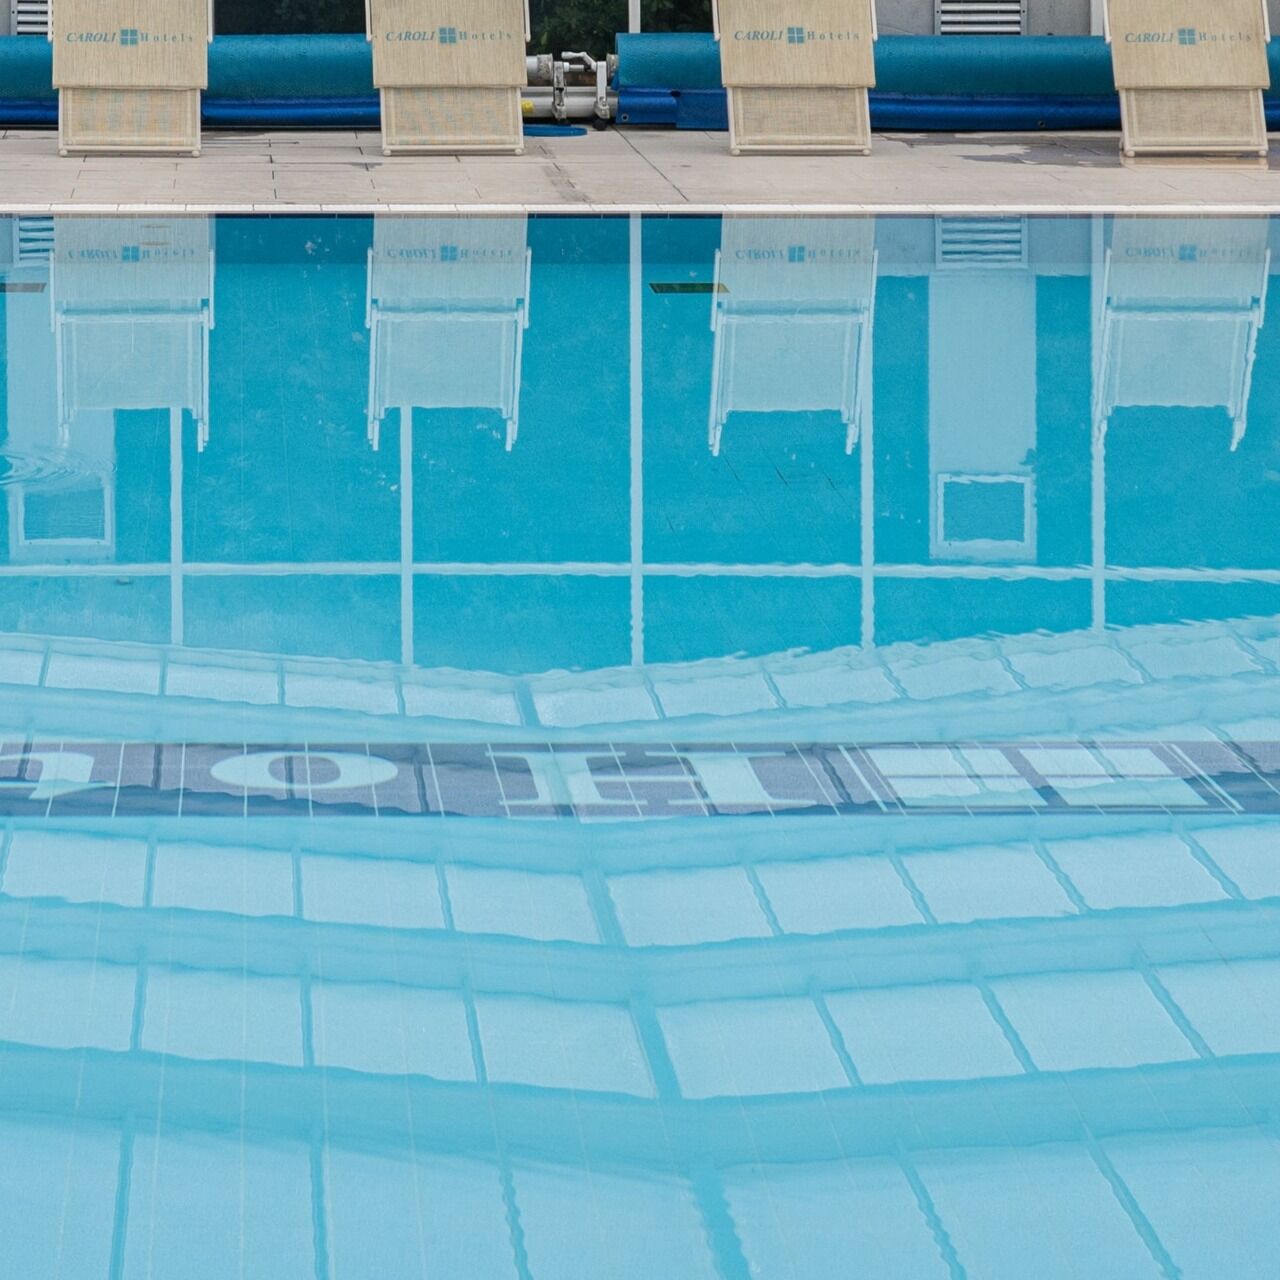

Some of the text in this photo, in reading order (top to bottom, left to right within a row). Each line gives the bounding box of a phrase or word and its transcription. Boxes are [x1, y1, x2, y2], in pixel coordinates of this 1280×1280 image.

[66, 32, 193, 42] CAROLI Hotels
[385, 31, 512, 41] CAROLI Hotels
[734, 30, 860, 41] CAROLI Hotels
[1124, 32, 1252, 42] CAROLI Hotels
